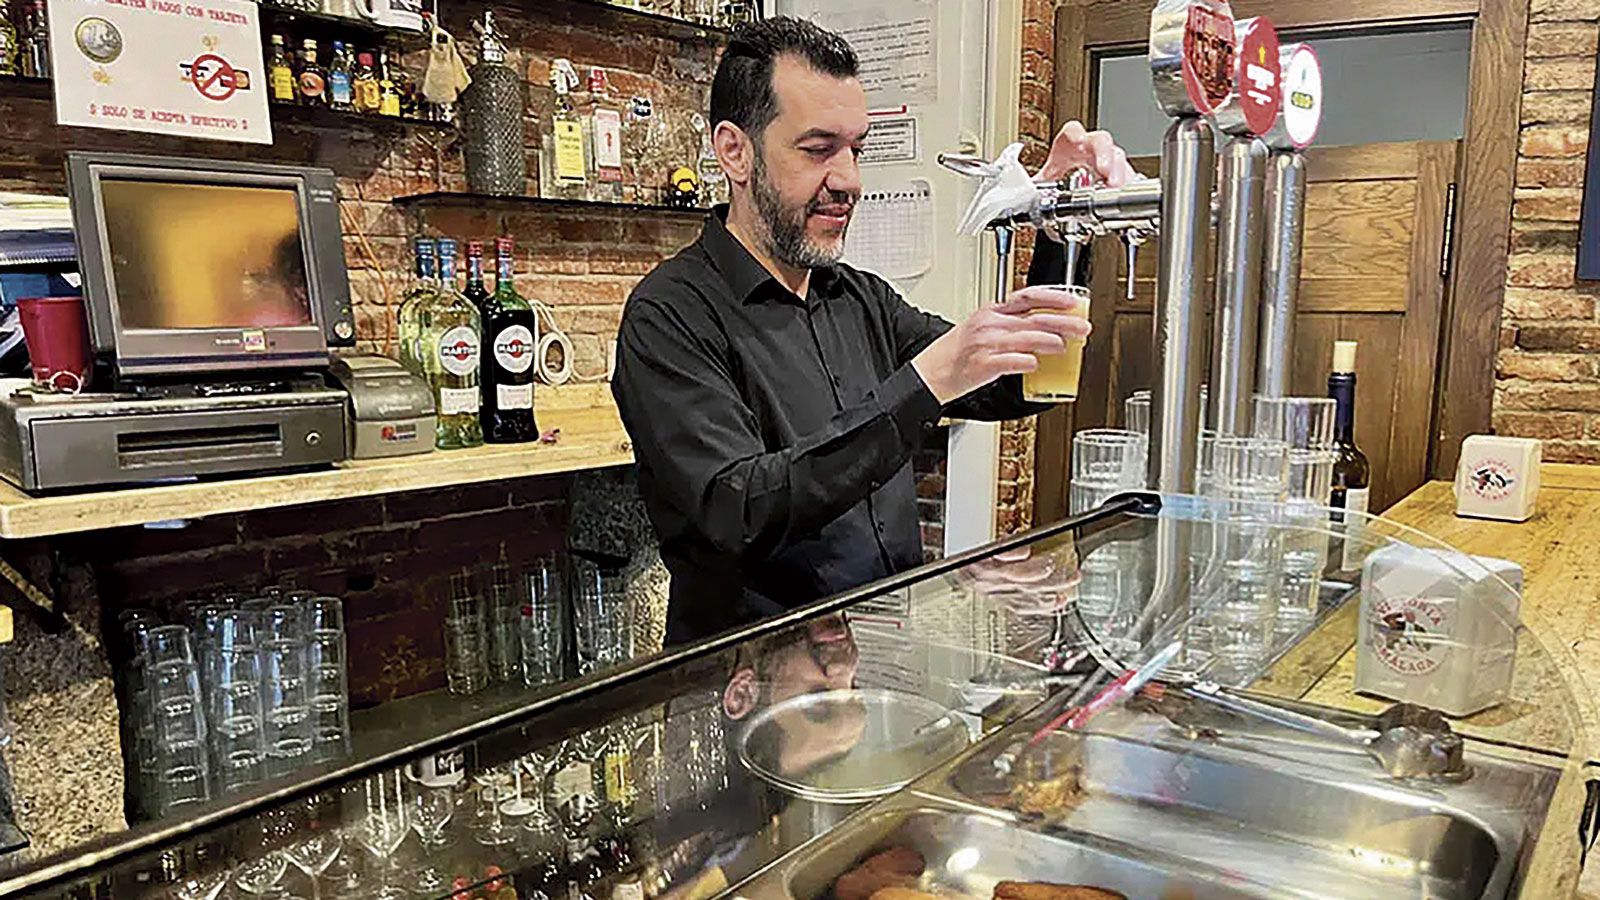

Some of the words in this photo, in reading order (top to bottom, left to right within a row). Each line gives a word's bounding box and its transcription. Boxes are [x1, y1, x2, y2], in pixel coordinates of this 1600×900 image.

[152, 1, 182, 15] PAGOS
[186, 6, 205, 17] CON
[208, 10, 248, 24] TARJETA
[102, 105, 127, 118] SOLO
[133, 107, 146, 119] SE
[151, 110, 187, 124] ACEPTA
[191, 115, 237, 129] EFECTIVO
